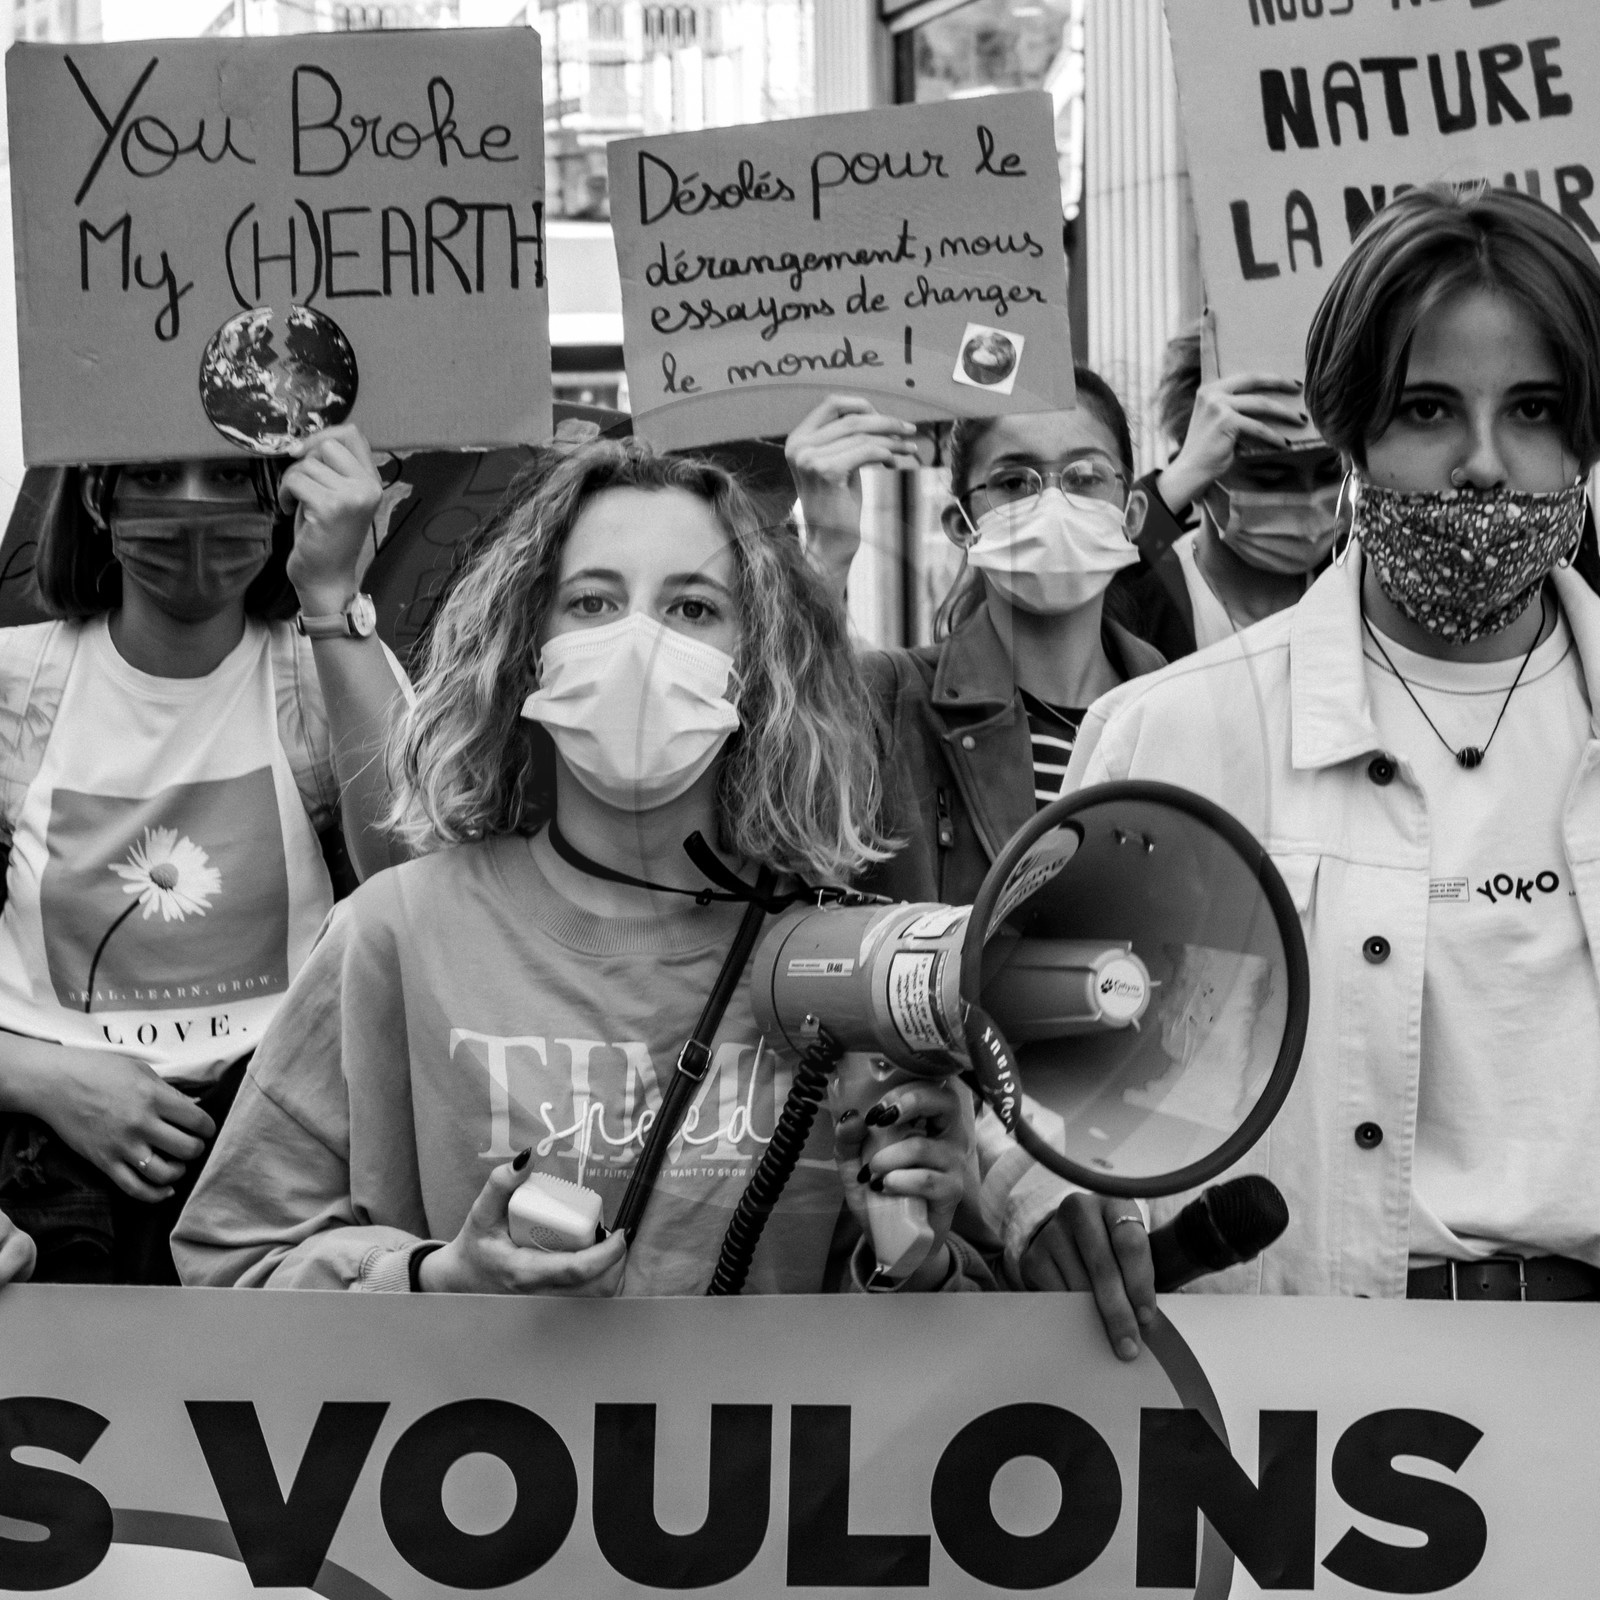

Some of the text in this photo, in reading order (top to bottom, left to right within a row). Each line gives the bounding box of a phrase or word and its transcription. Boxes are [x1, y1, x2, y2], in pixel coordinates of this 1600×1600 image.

[1260, 37, 1573, 151] NATURE
[64, 55, 519, 206] You Broke
[637, 125, 1028, 226] Désolés pour le
[79, 197, 544, 342] My (H)EARTH
[645, 219, 1044, 291] dérangement, nous
[1230, 189, 1323, 281] LA
[650, 275, 1048, 341] essayons de changer
[662, 351, 702, 394] le
[727, 336, 885, 386] monde
[1476, 870, 1560, 904] YOKO
[134, 984, 209, 1000] LEARN.
[103, 1014, 247, 1045] LOVE.
[670, 1168, 698, 1178] WANT
[702, 1167, 715, 1177] TO
[184, 1397, 1488, 1595] VOULONS
